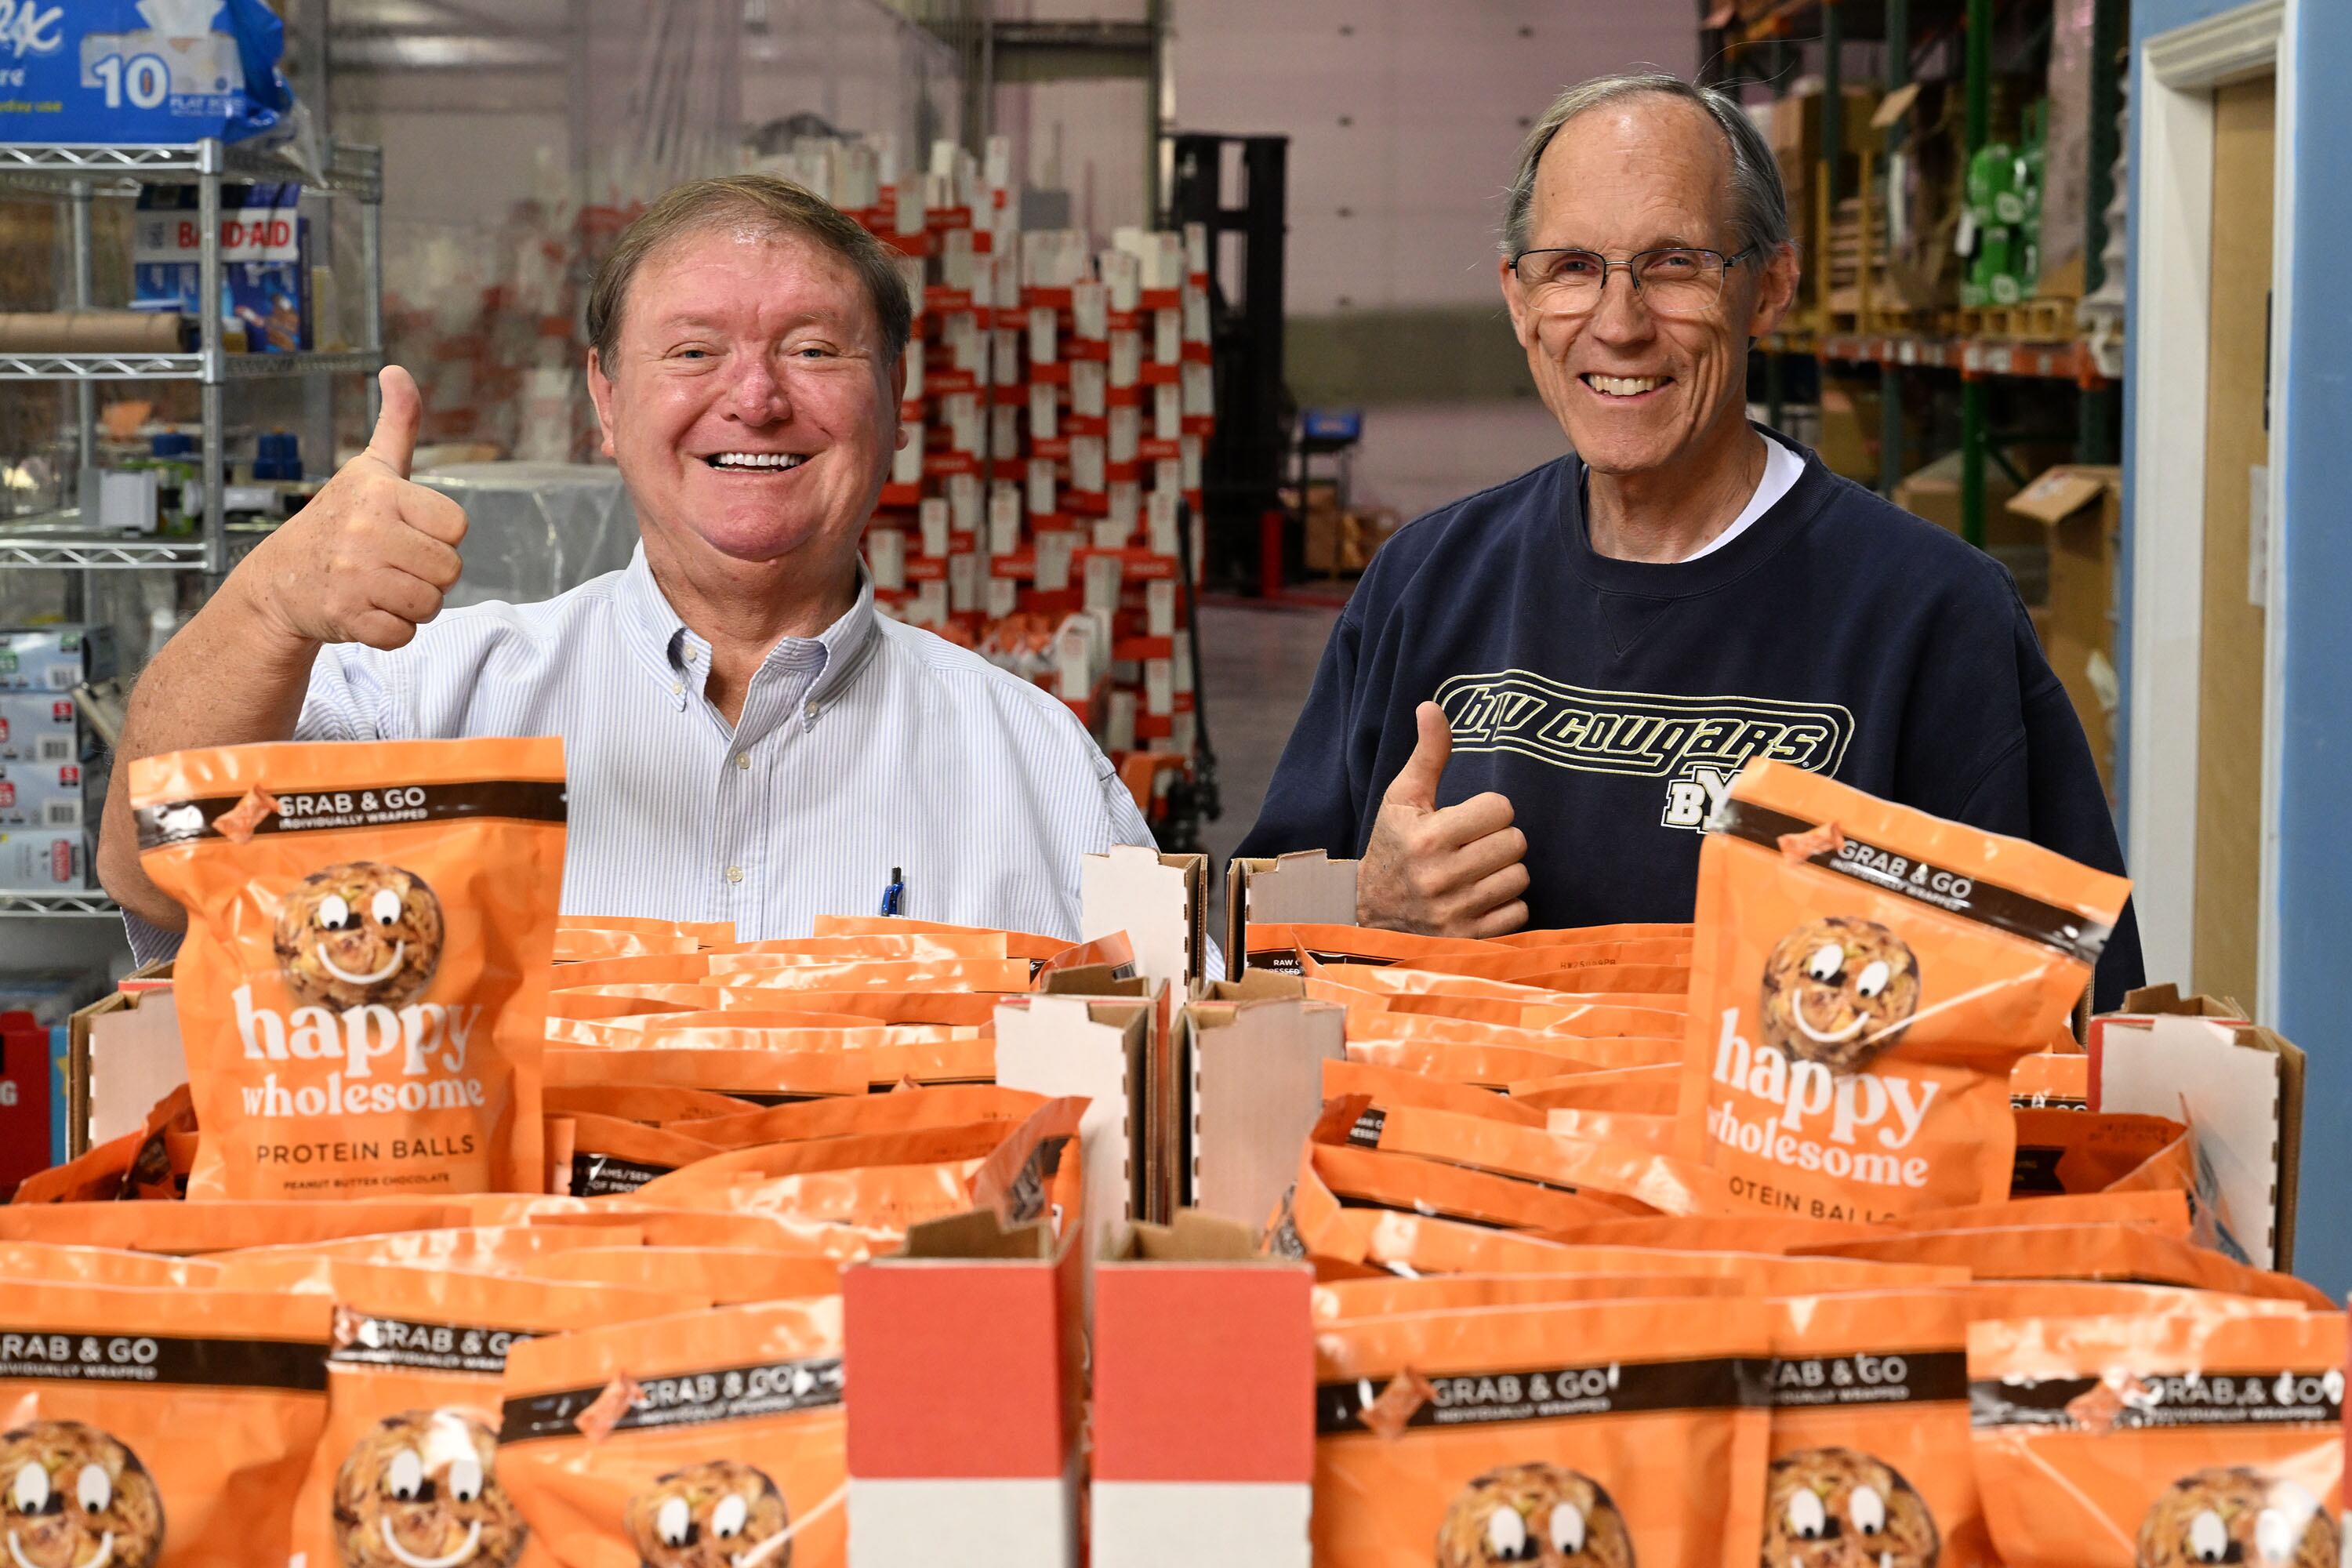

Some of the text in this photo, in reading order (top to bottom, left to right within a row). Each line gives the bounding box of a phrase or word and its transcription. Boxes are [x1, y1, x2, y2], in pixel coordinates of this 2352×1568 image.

[94, 54, 169, 109] 10
[278, 786, 426, 817] GRAB & GO
[1663, 767, 1743, 833] BY
[1837, 840, 1972, 898] GRAB & GO
[232, 984, 484, 1078] happy
[241, 1071, 485, 1117] wholesome
[1712, 1007, 1940, 1149] happy
[257, 1134, 474, 1164] PROTEIN BALLS
[1706, 1100, 1929, 1187] wholesome
[1728, 1175, 1801, 1212] OTEIN
[0, 1334, 158, 1364] RAB & GO
[460, 1330, 482, 1356] &
[722, 1370, 743, 1399] &
[748, 1365, 793, 1398] GO
[1431, 1368, 1608, 1408] GRAB & GO
[1831, 1358, 1854, 1387] &
[1857, 1356, 1907, 1385] GO
